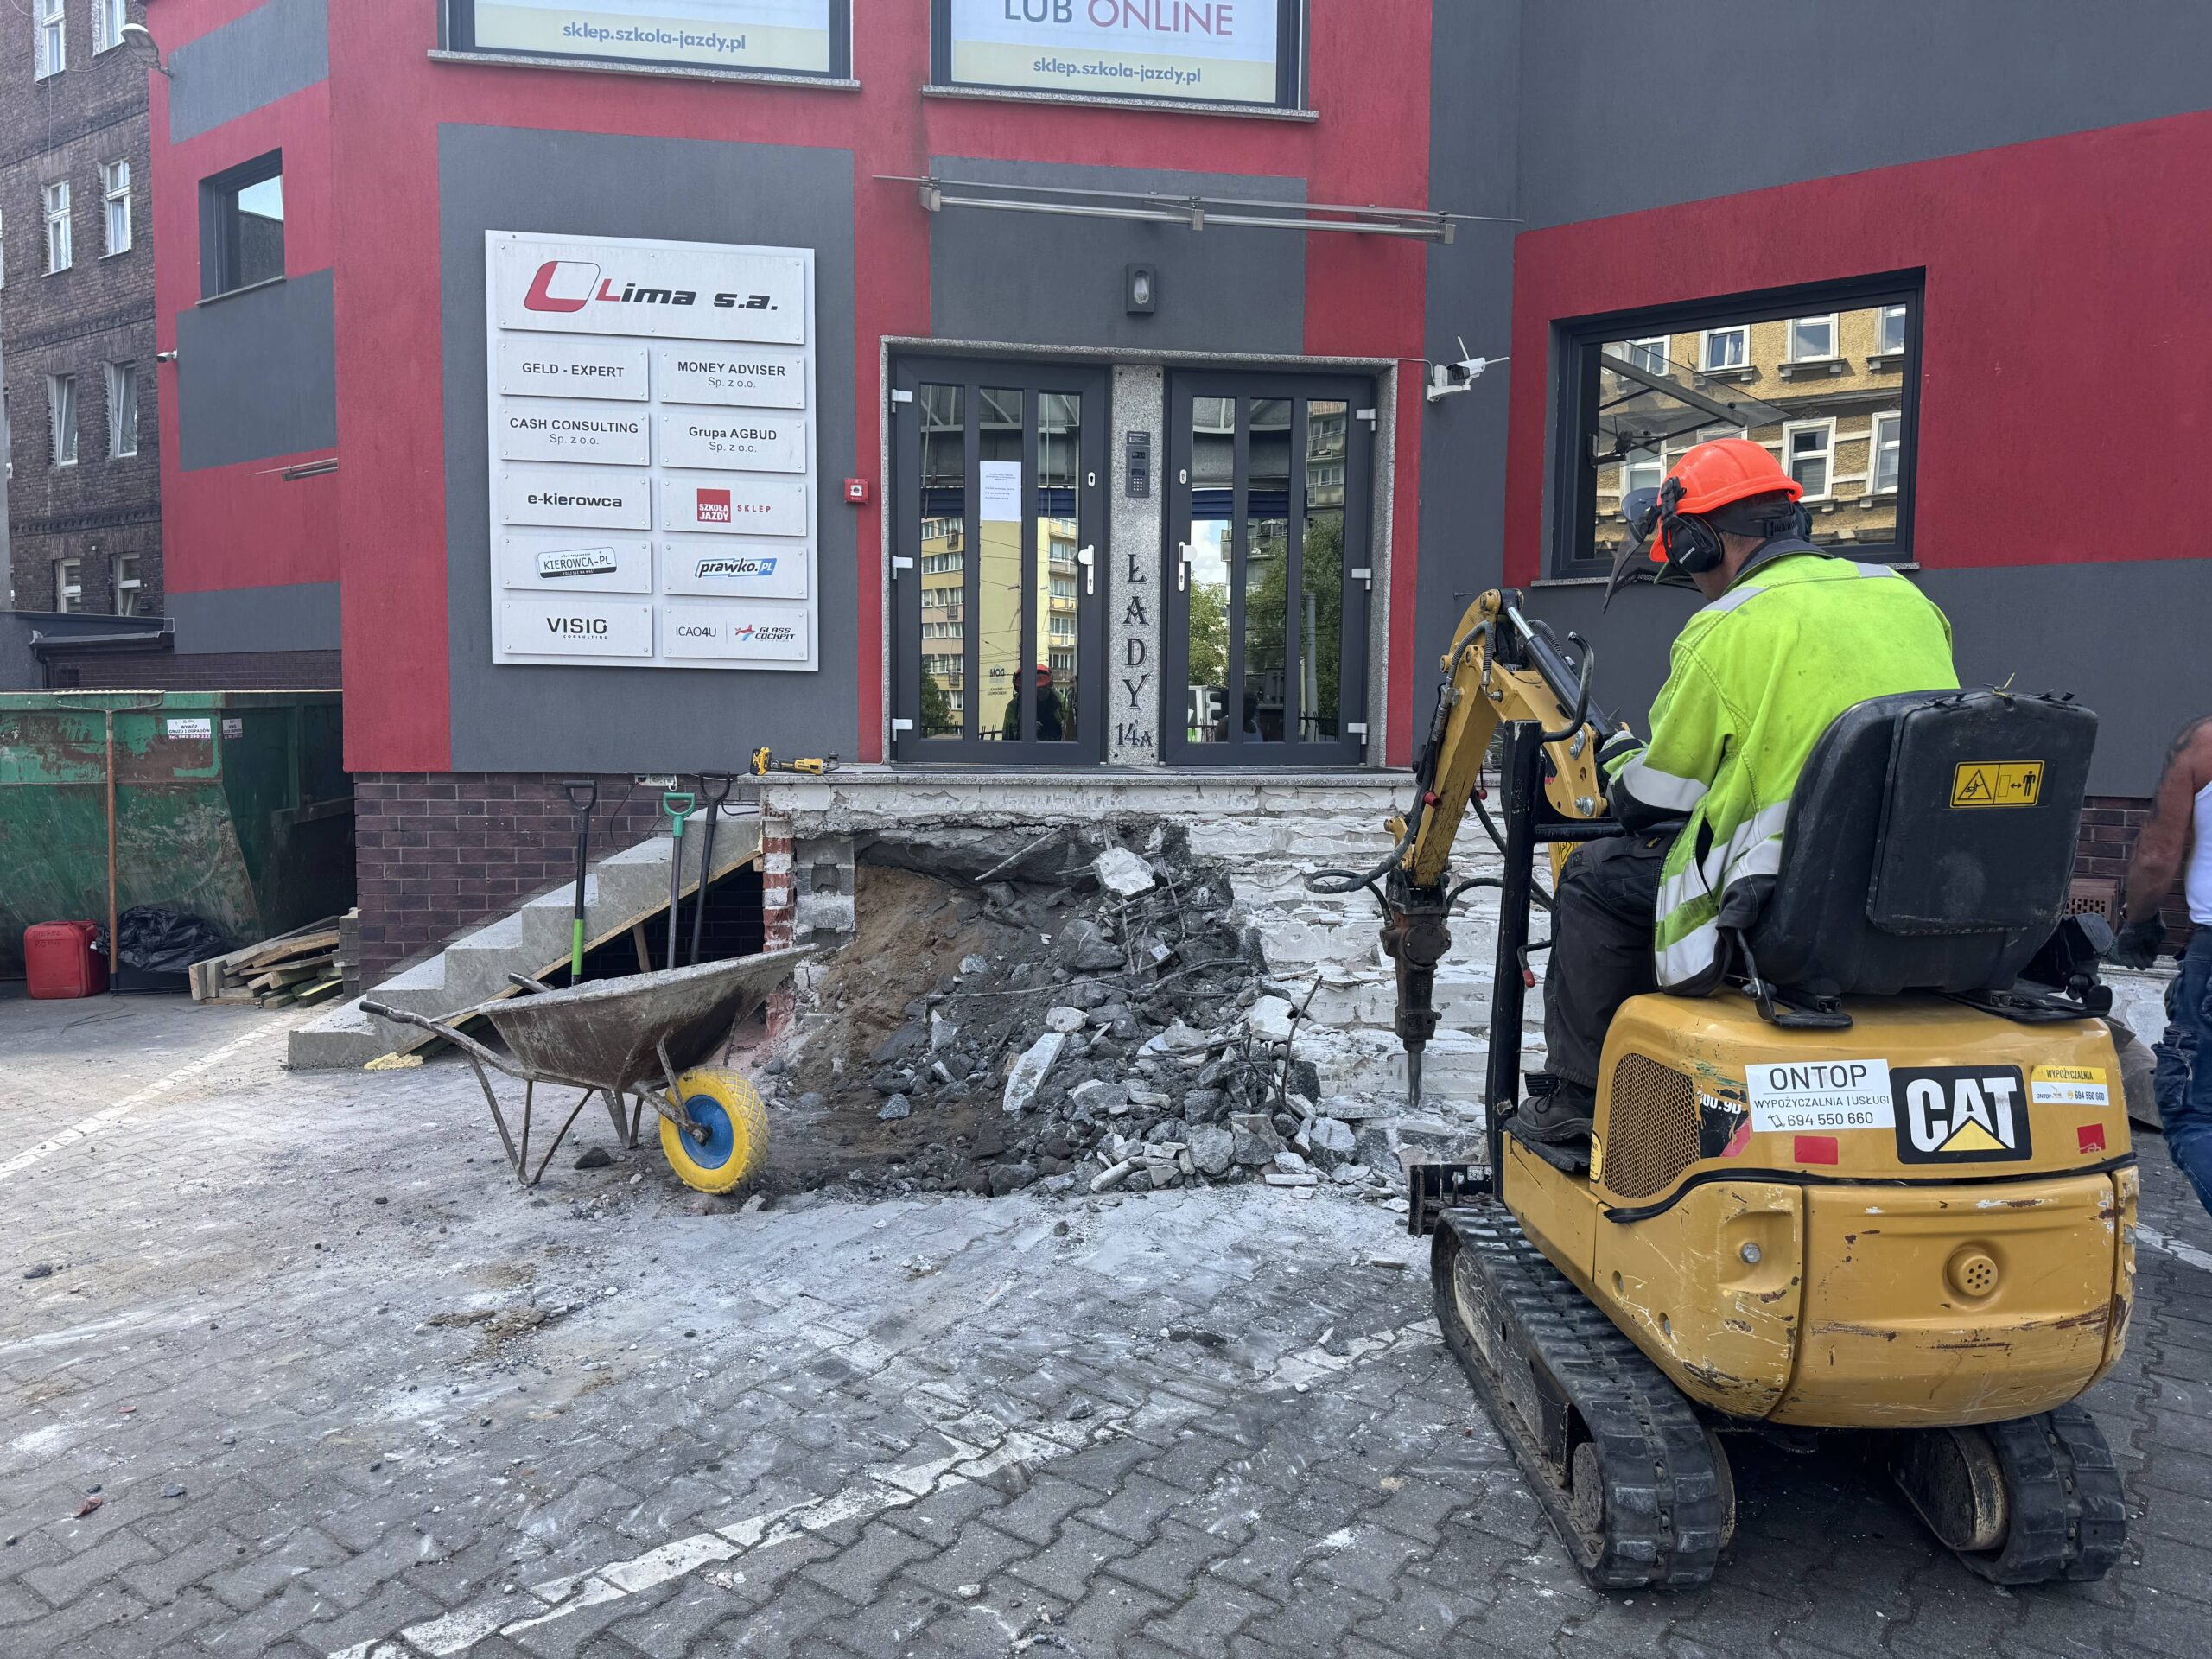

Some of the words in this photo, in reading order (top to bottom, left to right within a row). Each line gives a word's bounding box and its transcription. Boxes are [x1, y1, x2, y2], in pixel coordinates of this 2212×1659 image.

[1005, 0, 1072, 23] LUB
[1088, 0, 1233, 35] ONLINE
[563, 22, 747, 52] sklep.szkola-jazdy.pl
[1033, 57, 1202, 85] sklep.szkola-jazdy.pl
[595, 278, 697, 305] Lima
[714, 293, 778, 310] s.a.
[522, 362, 559, 374] GELD
[571, 365, 625, 377] EXPERT
[677, 361, 725, 373] MONEY
[728, 364, 785, 377] ADVISER
[708, 377, 725, 388] Sp.
[510, 417, 547, 429] CASH
[551, 419, 639, 433] CONSULTING
[550, 434, 567, 445] Sp.
[580, 436, 599, 445] o.o.
[689, 426, 727, 440] Grupa
[729, 428, 777, 441] AGBUD
[709, 441, 726, 453] Sp.
[738, 444, 757, 453] o.o.
[527, 492, 623, 507] e-kierowca
[698, 503, 729, 512] SZKOŁA
[737, 504, 772, 513] SKLEP
[699, 512, 729, 521] JAZDY
[543, 556, 612, 570] KIEROWCA-PL
[675, 626, 717, 638] ICAO4U
[1122, 554, 1151, 709] ŁADY
[1770, 1065, 1867, 1090] ONTOP
[2046, 1067, 2094, 1080] WYPOŻYCZALNIA
[1699, 1090, 1742, 1115] 00.9D
[1754, 1096, 1843, 1109] WYPOŻYCZALNIA
[1853, 1095, 1890, 1106] USŁUGI
[2075, 1090, 2085, 1100] 694
[2085, 1091, 2094, 1100] 550
[2095, 1092, 2105, 1101] 660
[1787, 1114, 1814, 1127] 694
[1817, 1113, 1844, 1125] 550
[1847, 1111, 1873, 1124] 660
[1906, 1077, 2017, 1152] CAT
